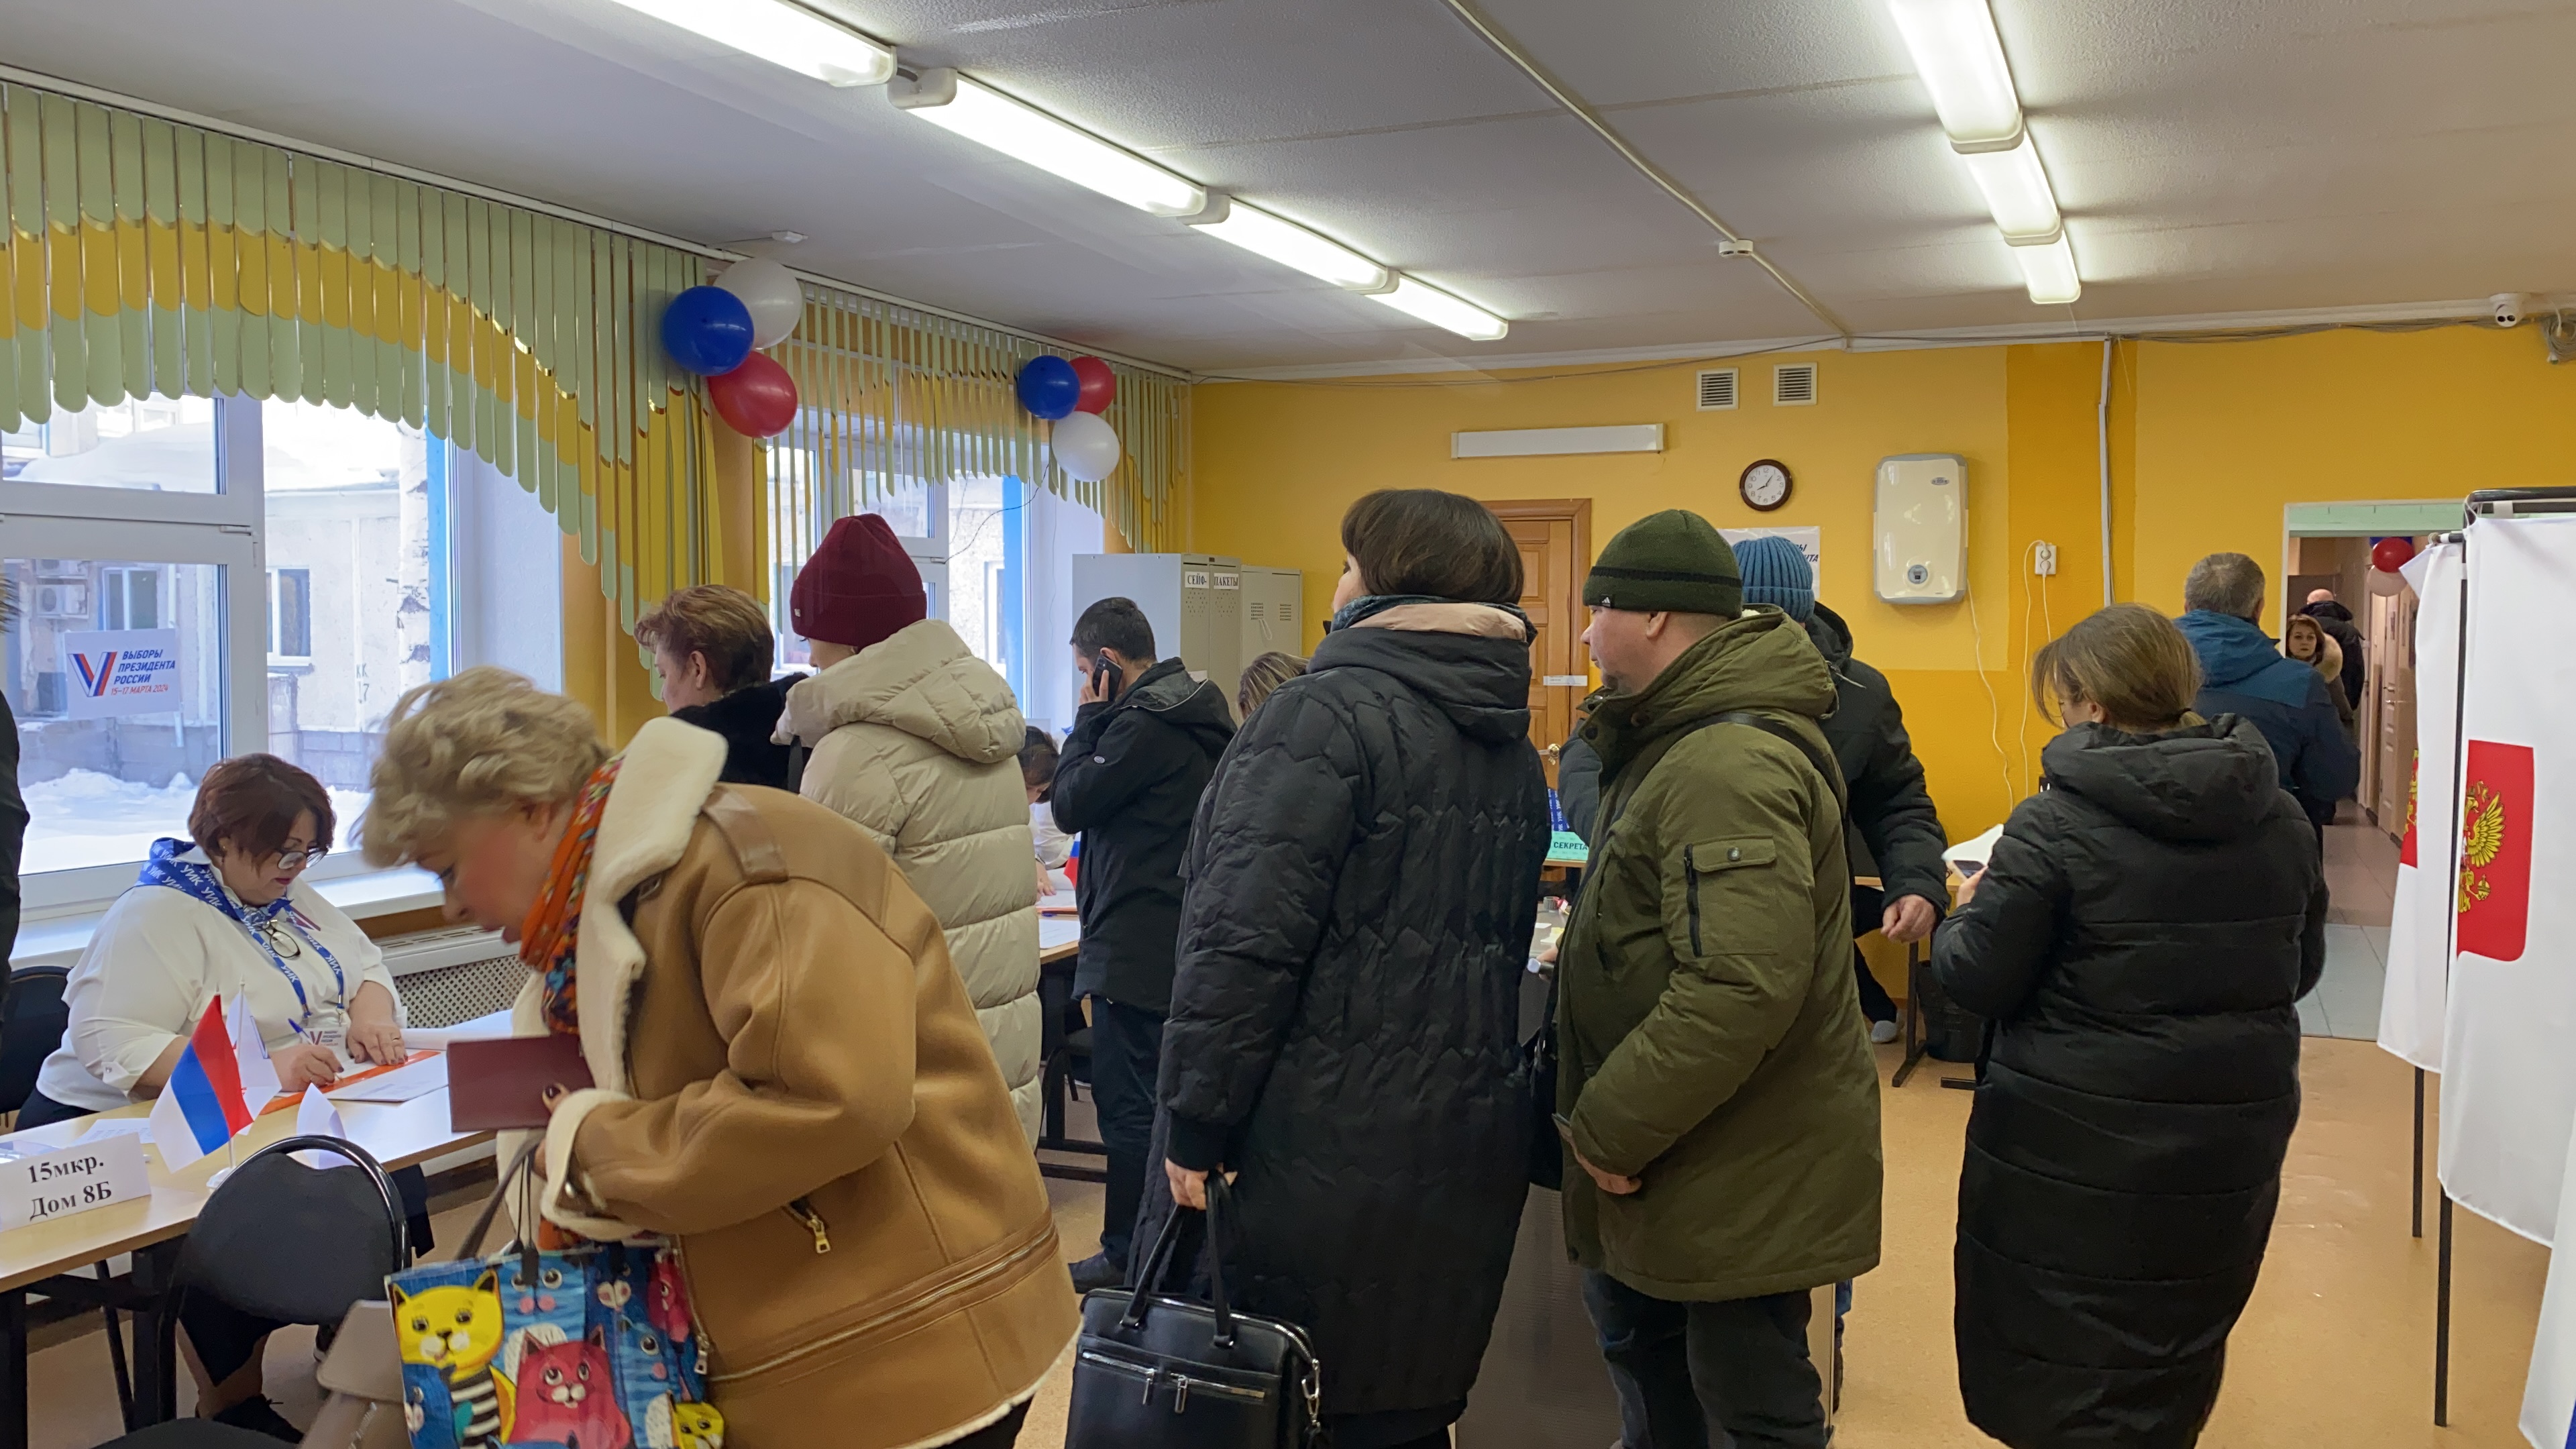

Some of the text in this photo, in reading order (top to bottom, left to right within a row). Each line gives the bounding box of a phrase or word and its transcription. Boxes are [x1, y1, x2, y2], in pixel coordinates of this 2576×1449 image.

[1214, 577, 1238, 586] ПАКЕТЫ
[122, 649, 163, 660] ВЫБОРЫ
[118, 660, 175, 672] ПРЕЗИДЕНТА
[114, 674, 151, 684] РОССИИ
[129, 686, 152, 694] МАРТА
[153, 684, 168, 692] 2024
[180, 865, 204, 885] УИК
[201, 886, 223, 907] УИК
[240, 915, 258, 935] УИК
[281, 965, 299, 983] УИК
[325, 955, 341, 975] УИК
[28, 1156, 104, 1183] 15мкр.
[30, 1181, 112, 1222] Дом 8Б
